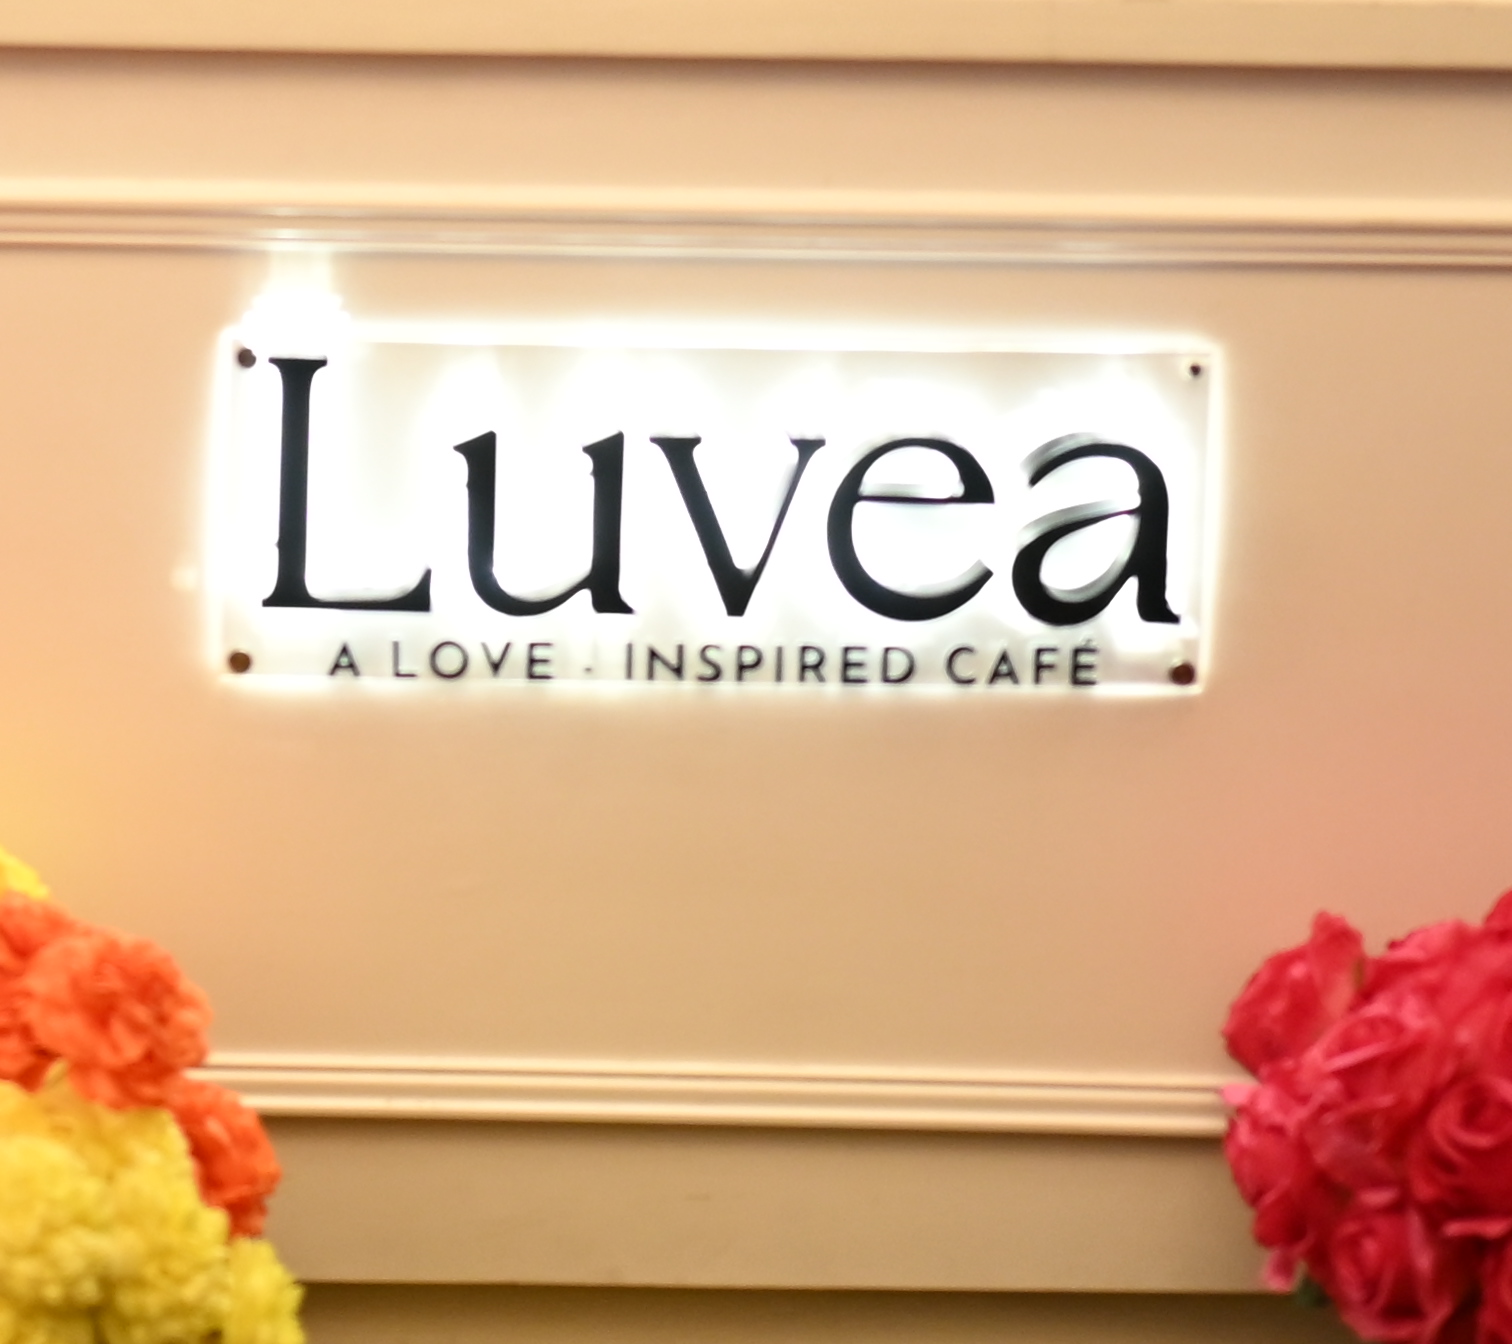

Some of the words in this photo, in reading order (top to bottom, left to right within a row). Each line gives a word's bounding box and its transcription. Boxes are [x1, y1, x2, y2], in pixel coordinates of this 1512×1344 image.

[261, 356, 1181, 627] Luvea
[328, 643, 361, 678] A
[391, 641, 554, 681] LOVE
[624, 642, 917, 684] INSPIRED
[944, 638, 1100, 687] CAFÉ
